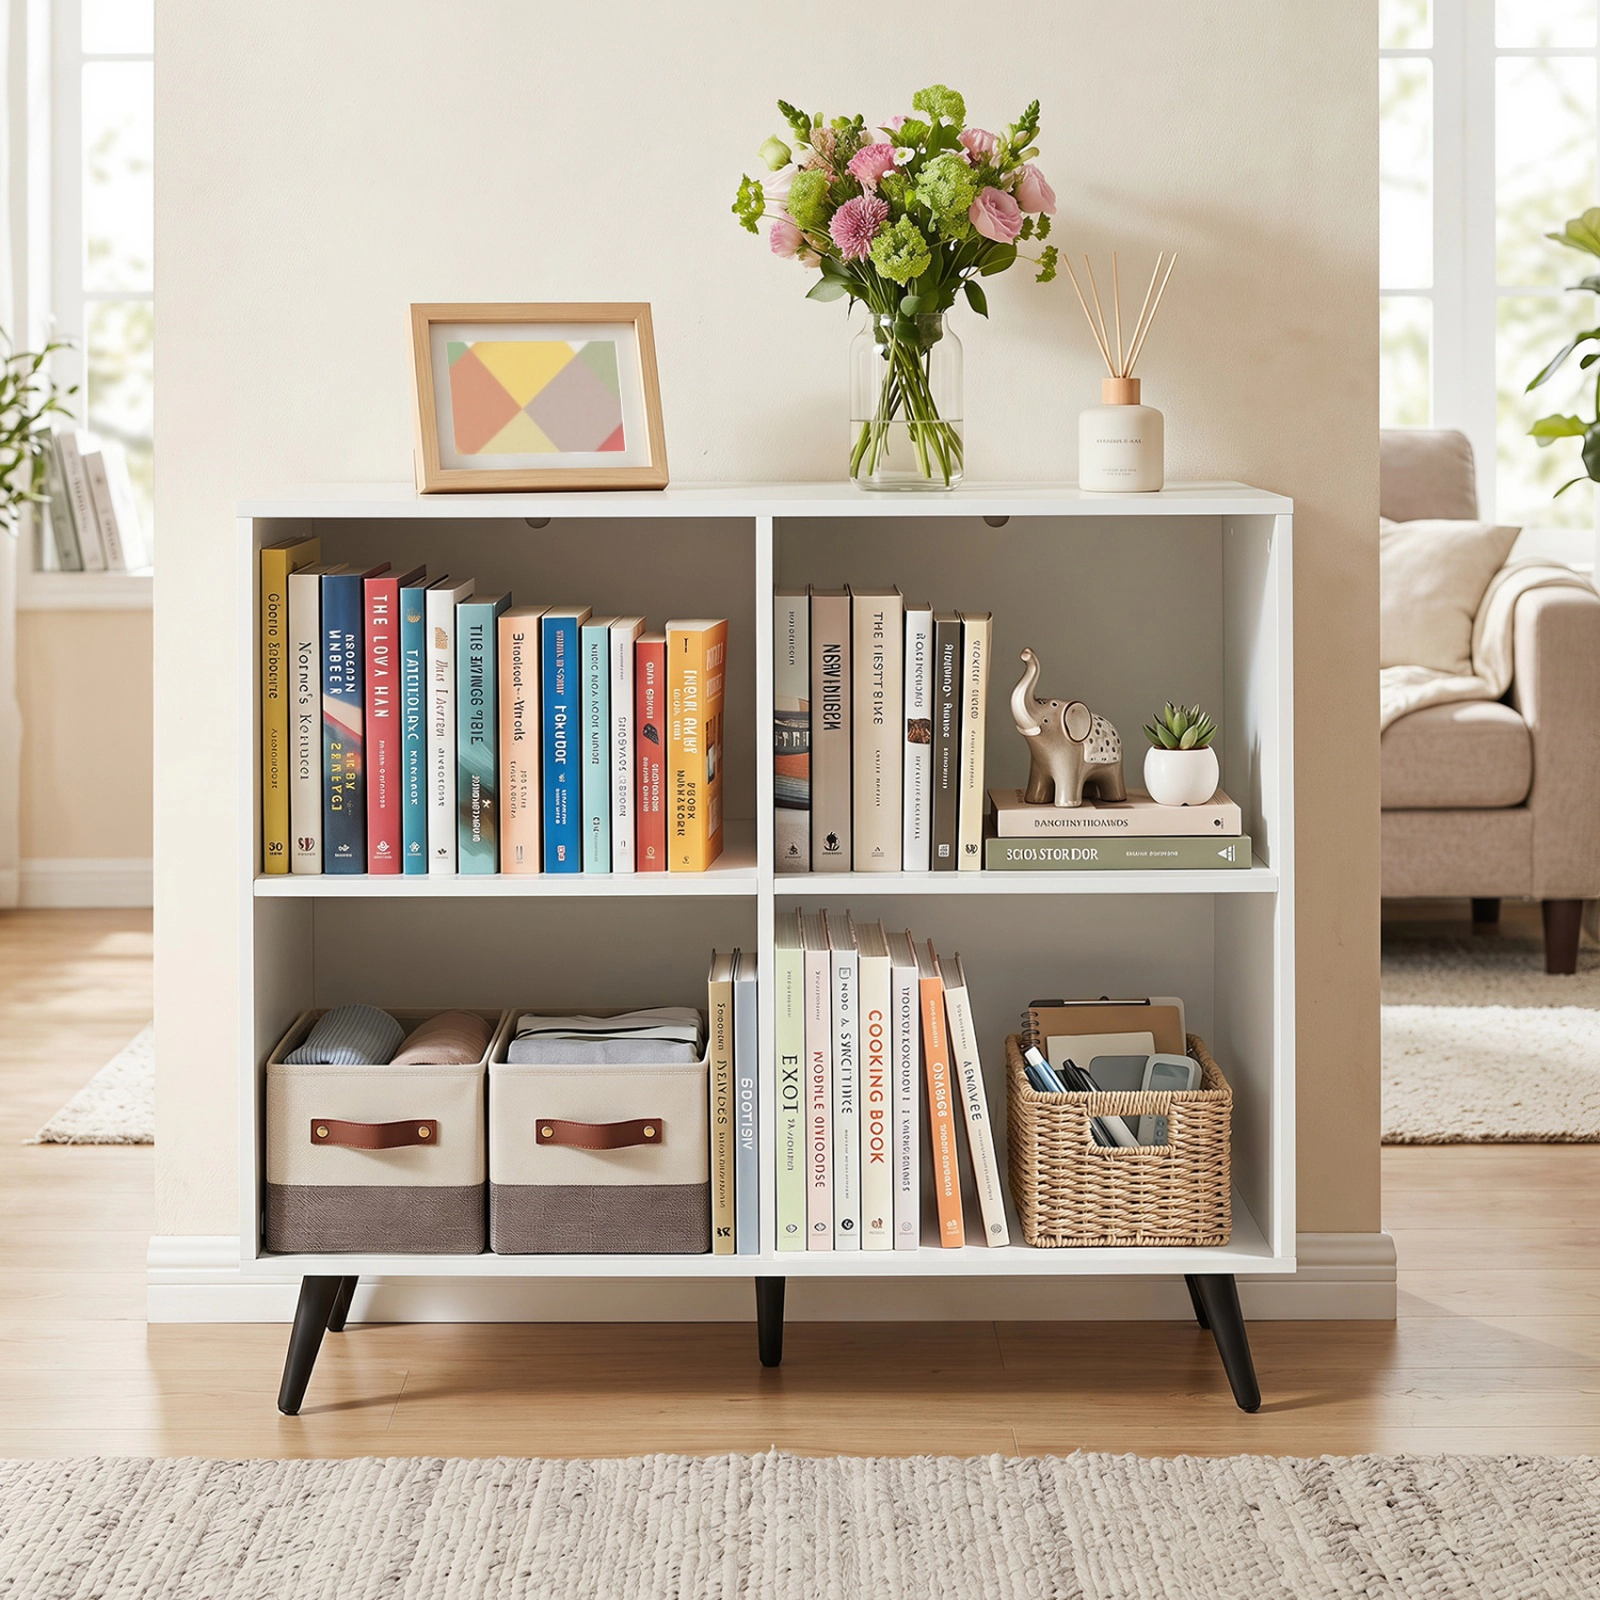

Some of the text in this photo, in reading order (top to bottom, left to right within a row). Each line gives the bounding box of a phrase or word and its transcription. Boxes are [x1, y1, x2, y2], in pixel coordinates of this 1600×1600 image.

[373, 594, 388, 625] THE
[782, 1054, 799, 1113] EXOT
[869, 1010, 884, 1164] COOKING BOOK
